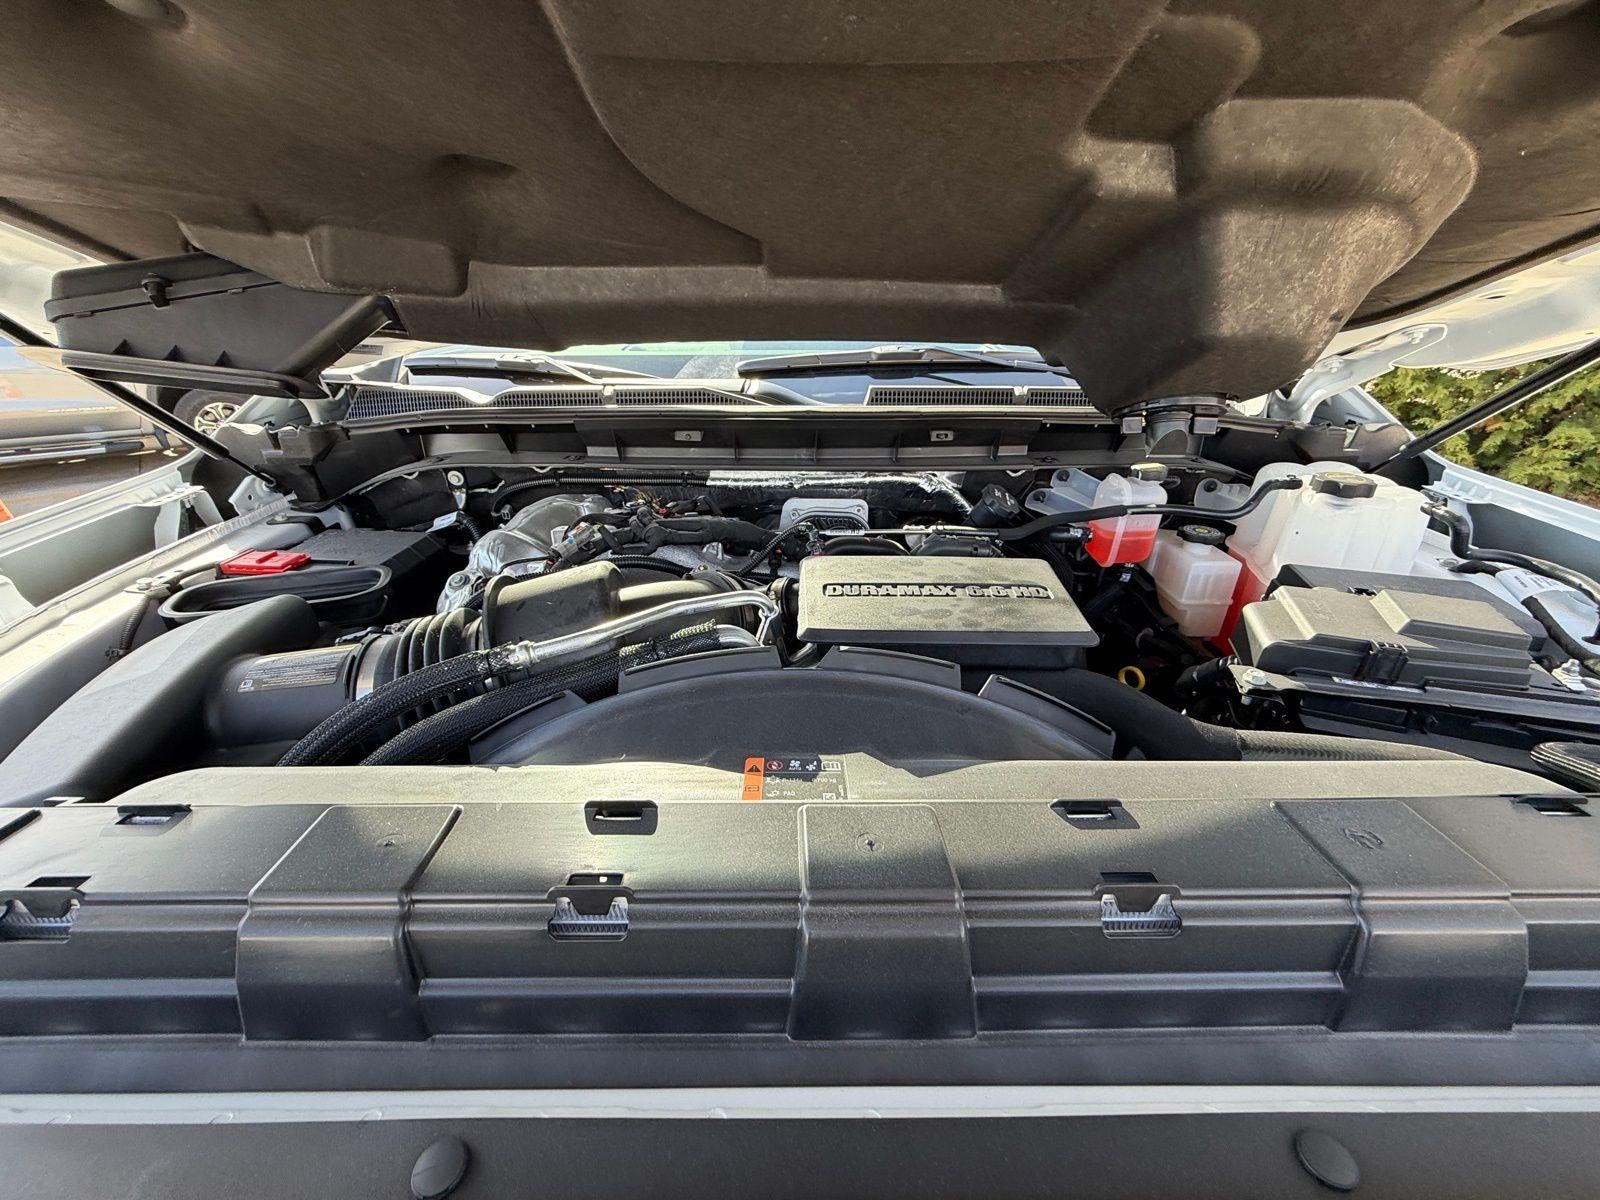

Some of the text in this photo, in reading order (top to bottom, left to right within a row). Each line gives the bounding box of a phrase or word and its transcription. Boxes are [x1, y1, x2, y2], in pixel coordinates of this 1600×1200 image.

[826, 583, 1051, 600] DURAMAX 6.6 HD
